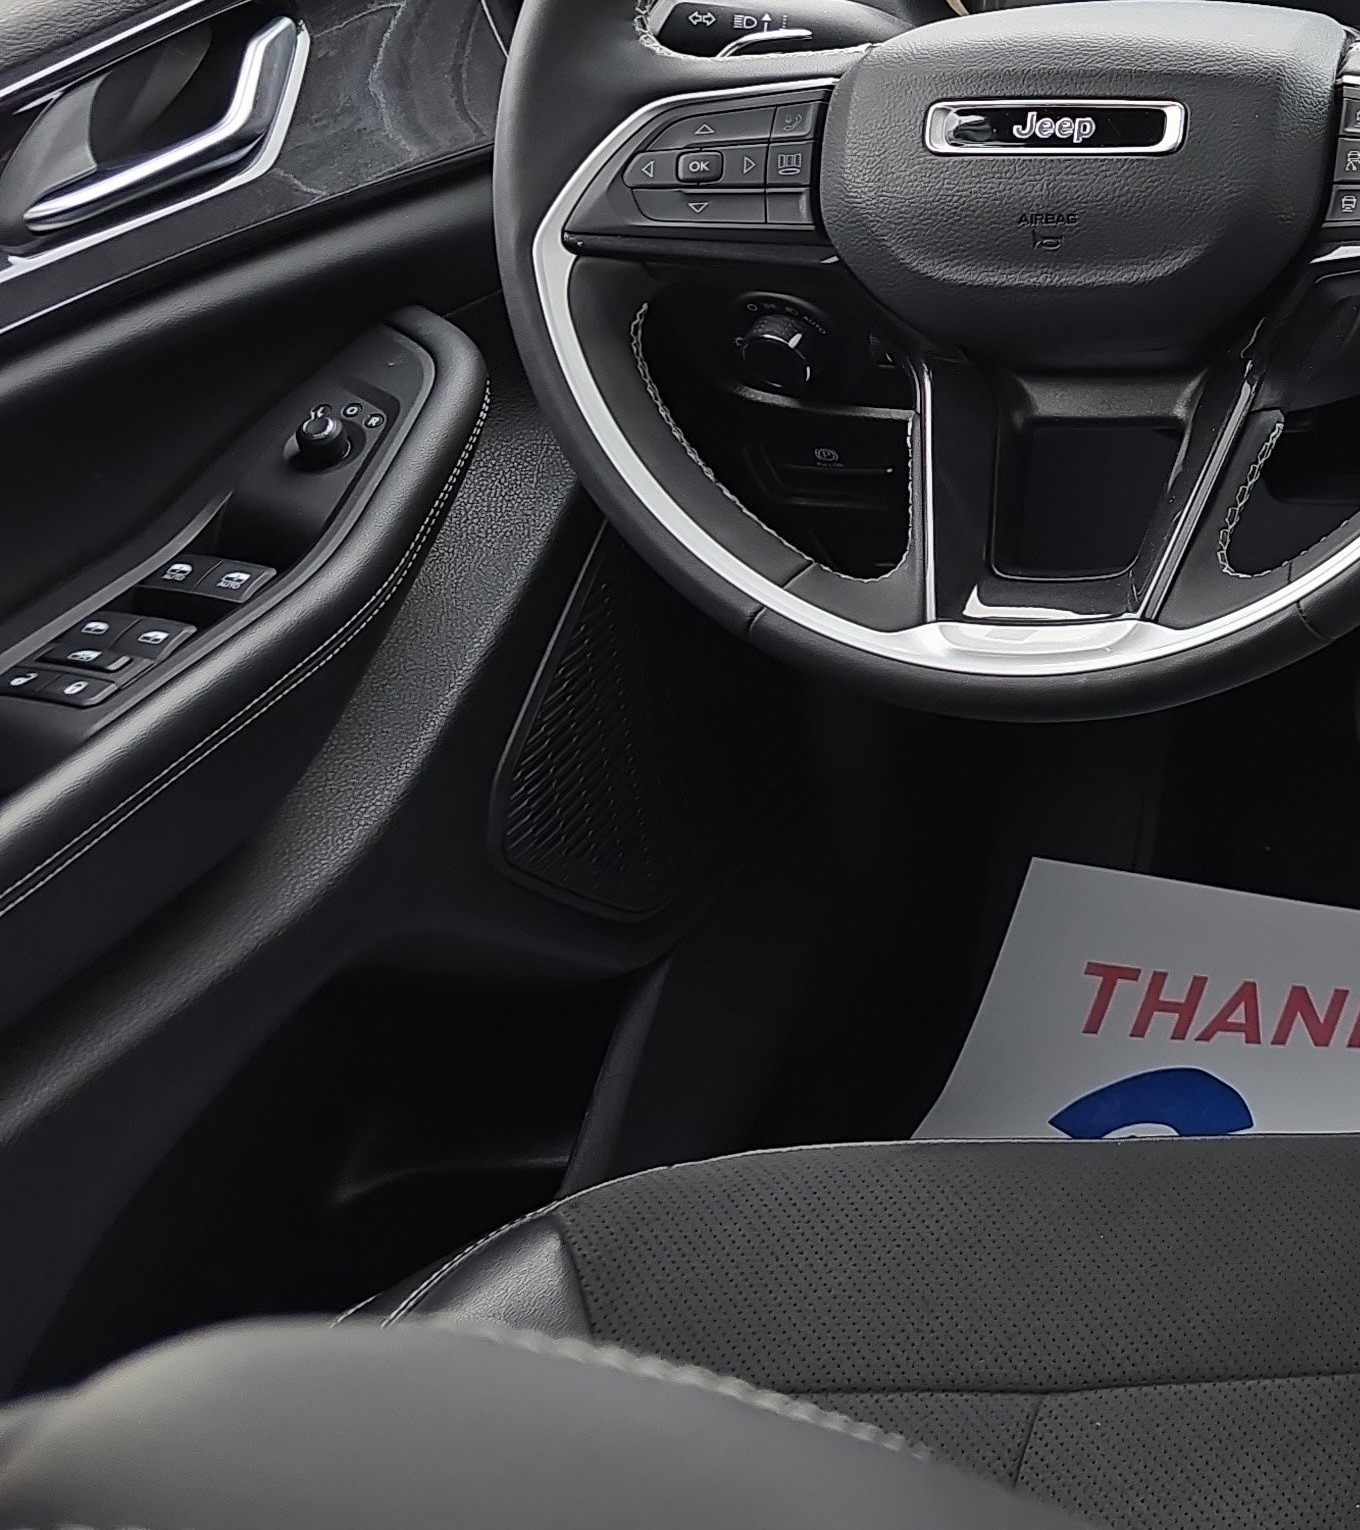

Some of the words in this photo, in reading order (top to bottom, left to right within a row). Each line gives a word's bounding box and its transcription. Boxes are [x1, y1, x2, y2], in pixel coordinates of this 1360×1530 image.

[1012, 111, 1096, 143] Jeep
[689, 160, 710, 172] OK
[1017, 213, 1079, 226] AIRBAG
